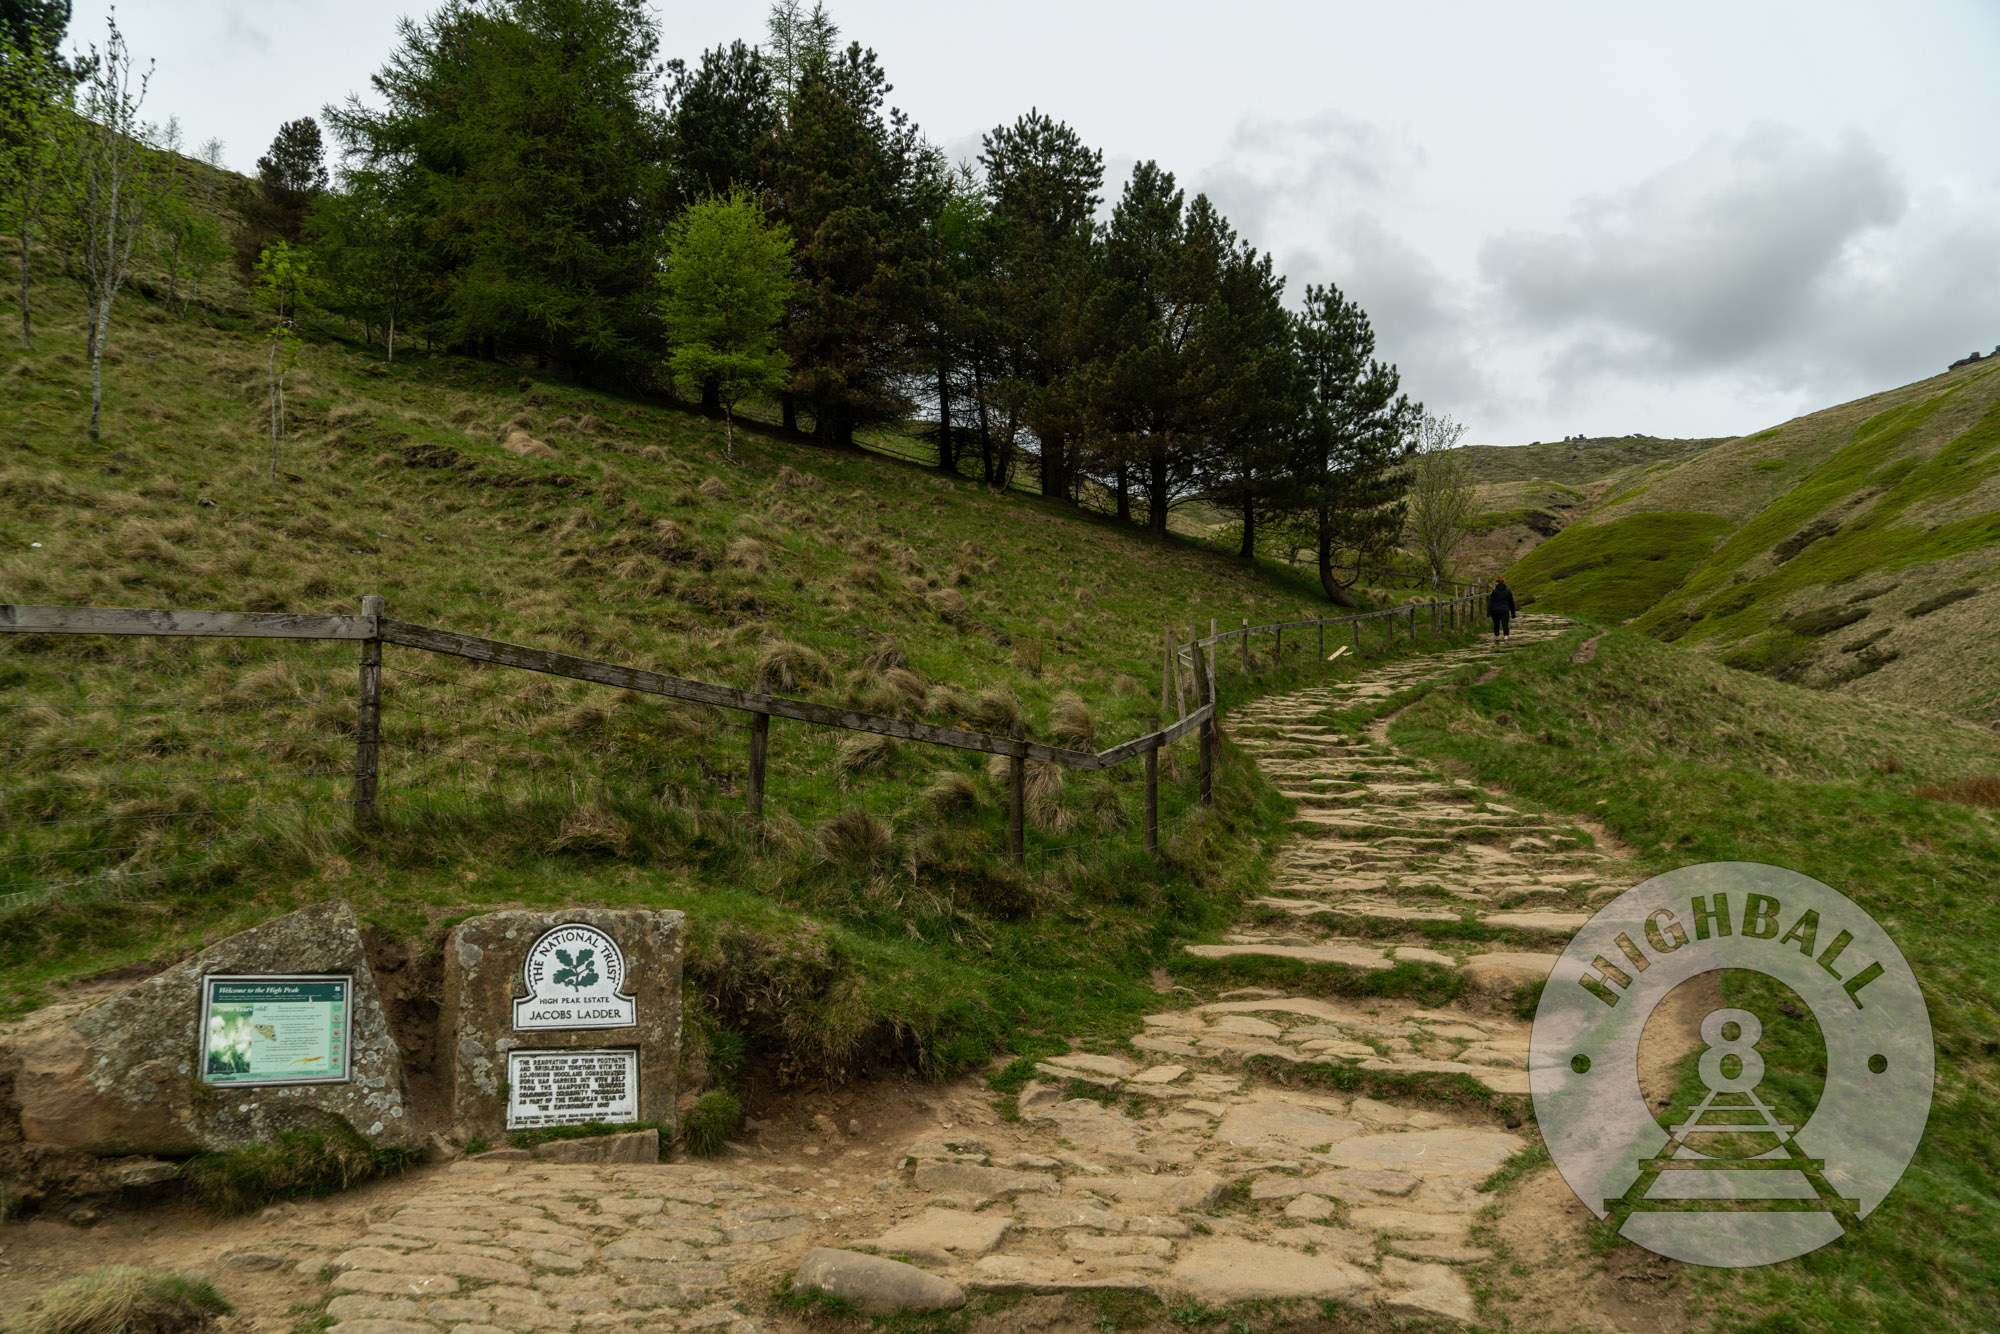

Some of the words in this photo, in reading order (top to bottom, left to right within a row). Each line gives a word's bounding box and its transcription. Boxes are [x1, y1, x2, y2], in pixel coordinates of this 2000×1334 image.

[533, 960, 545, 985] THE
[539, 932, 599, 957] NATIONAL
[600, 945, 617, 984] TRUST
[265, 987, 283, 995] High
[584, 996, 610, 1004] ESTATE
[529, 1010, 572, 1020] JACOBS
[577, 1009, 622, 1019] LADDER
